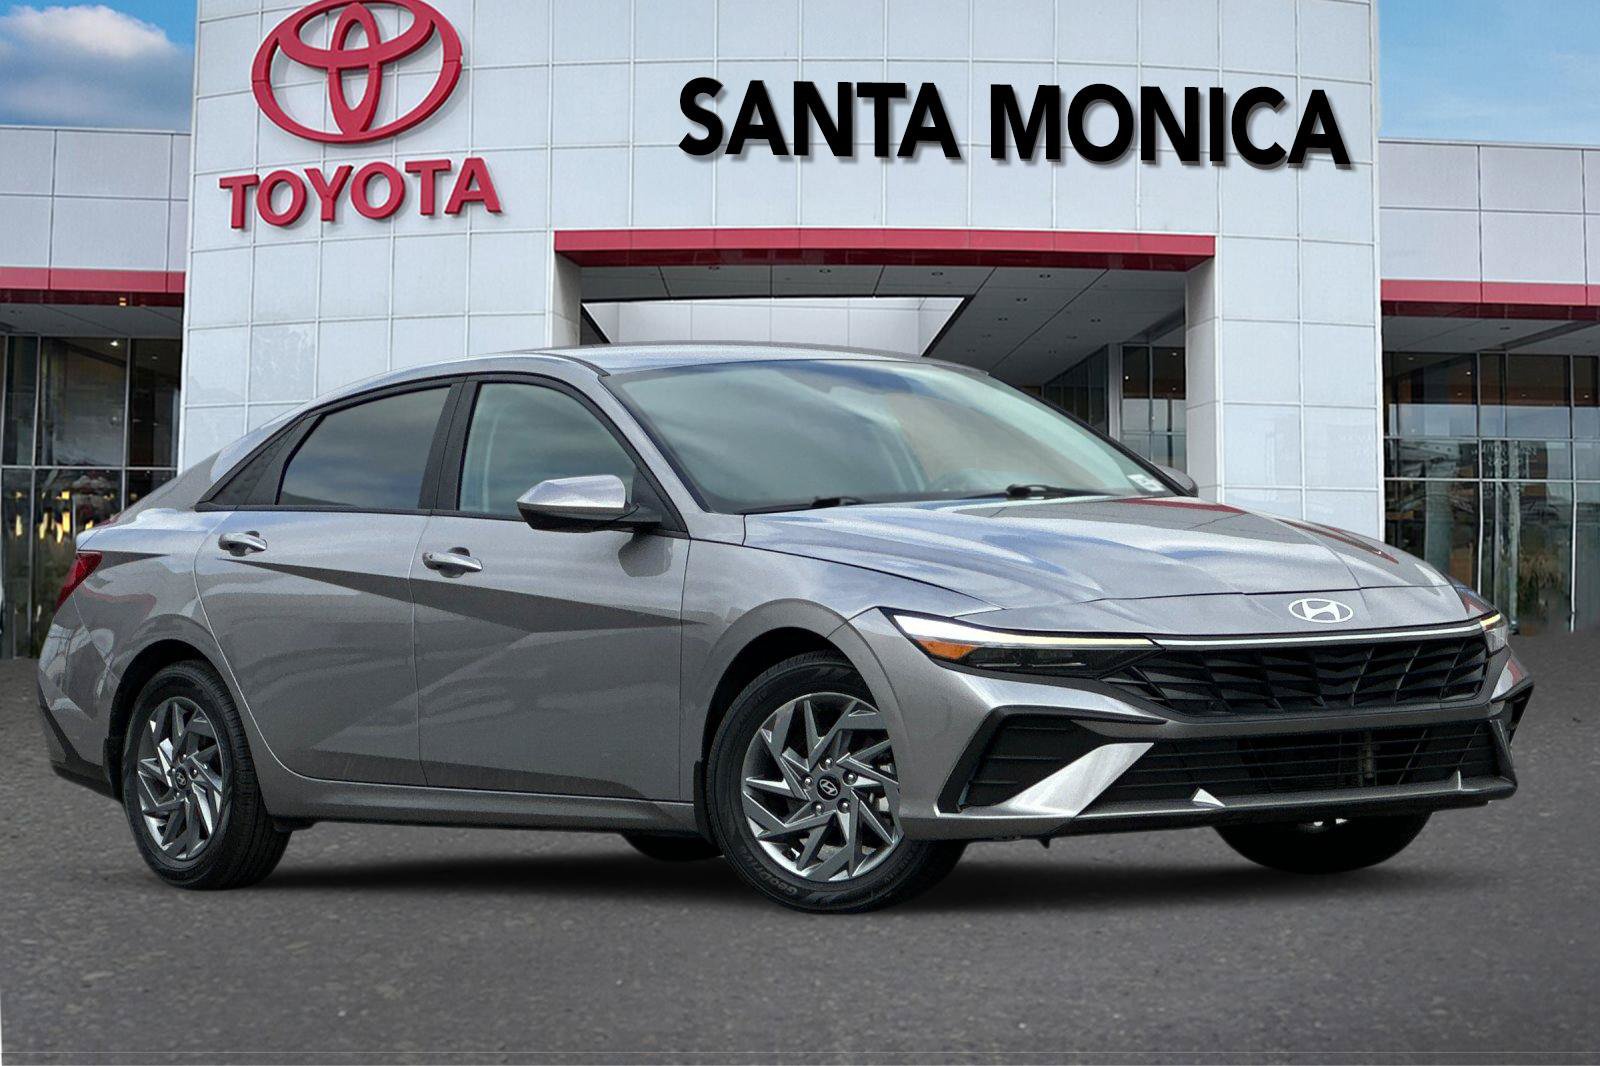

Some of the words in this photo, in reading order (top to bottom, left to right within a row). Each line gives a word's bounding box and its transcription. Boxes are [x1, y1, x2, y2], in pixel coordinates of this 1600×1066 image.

[679, 78, 962, 159] SANTA
[991, 84, 1352, 168] MONICA
[220, 158, 502, 229] TOYOTA
